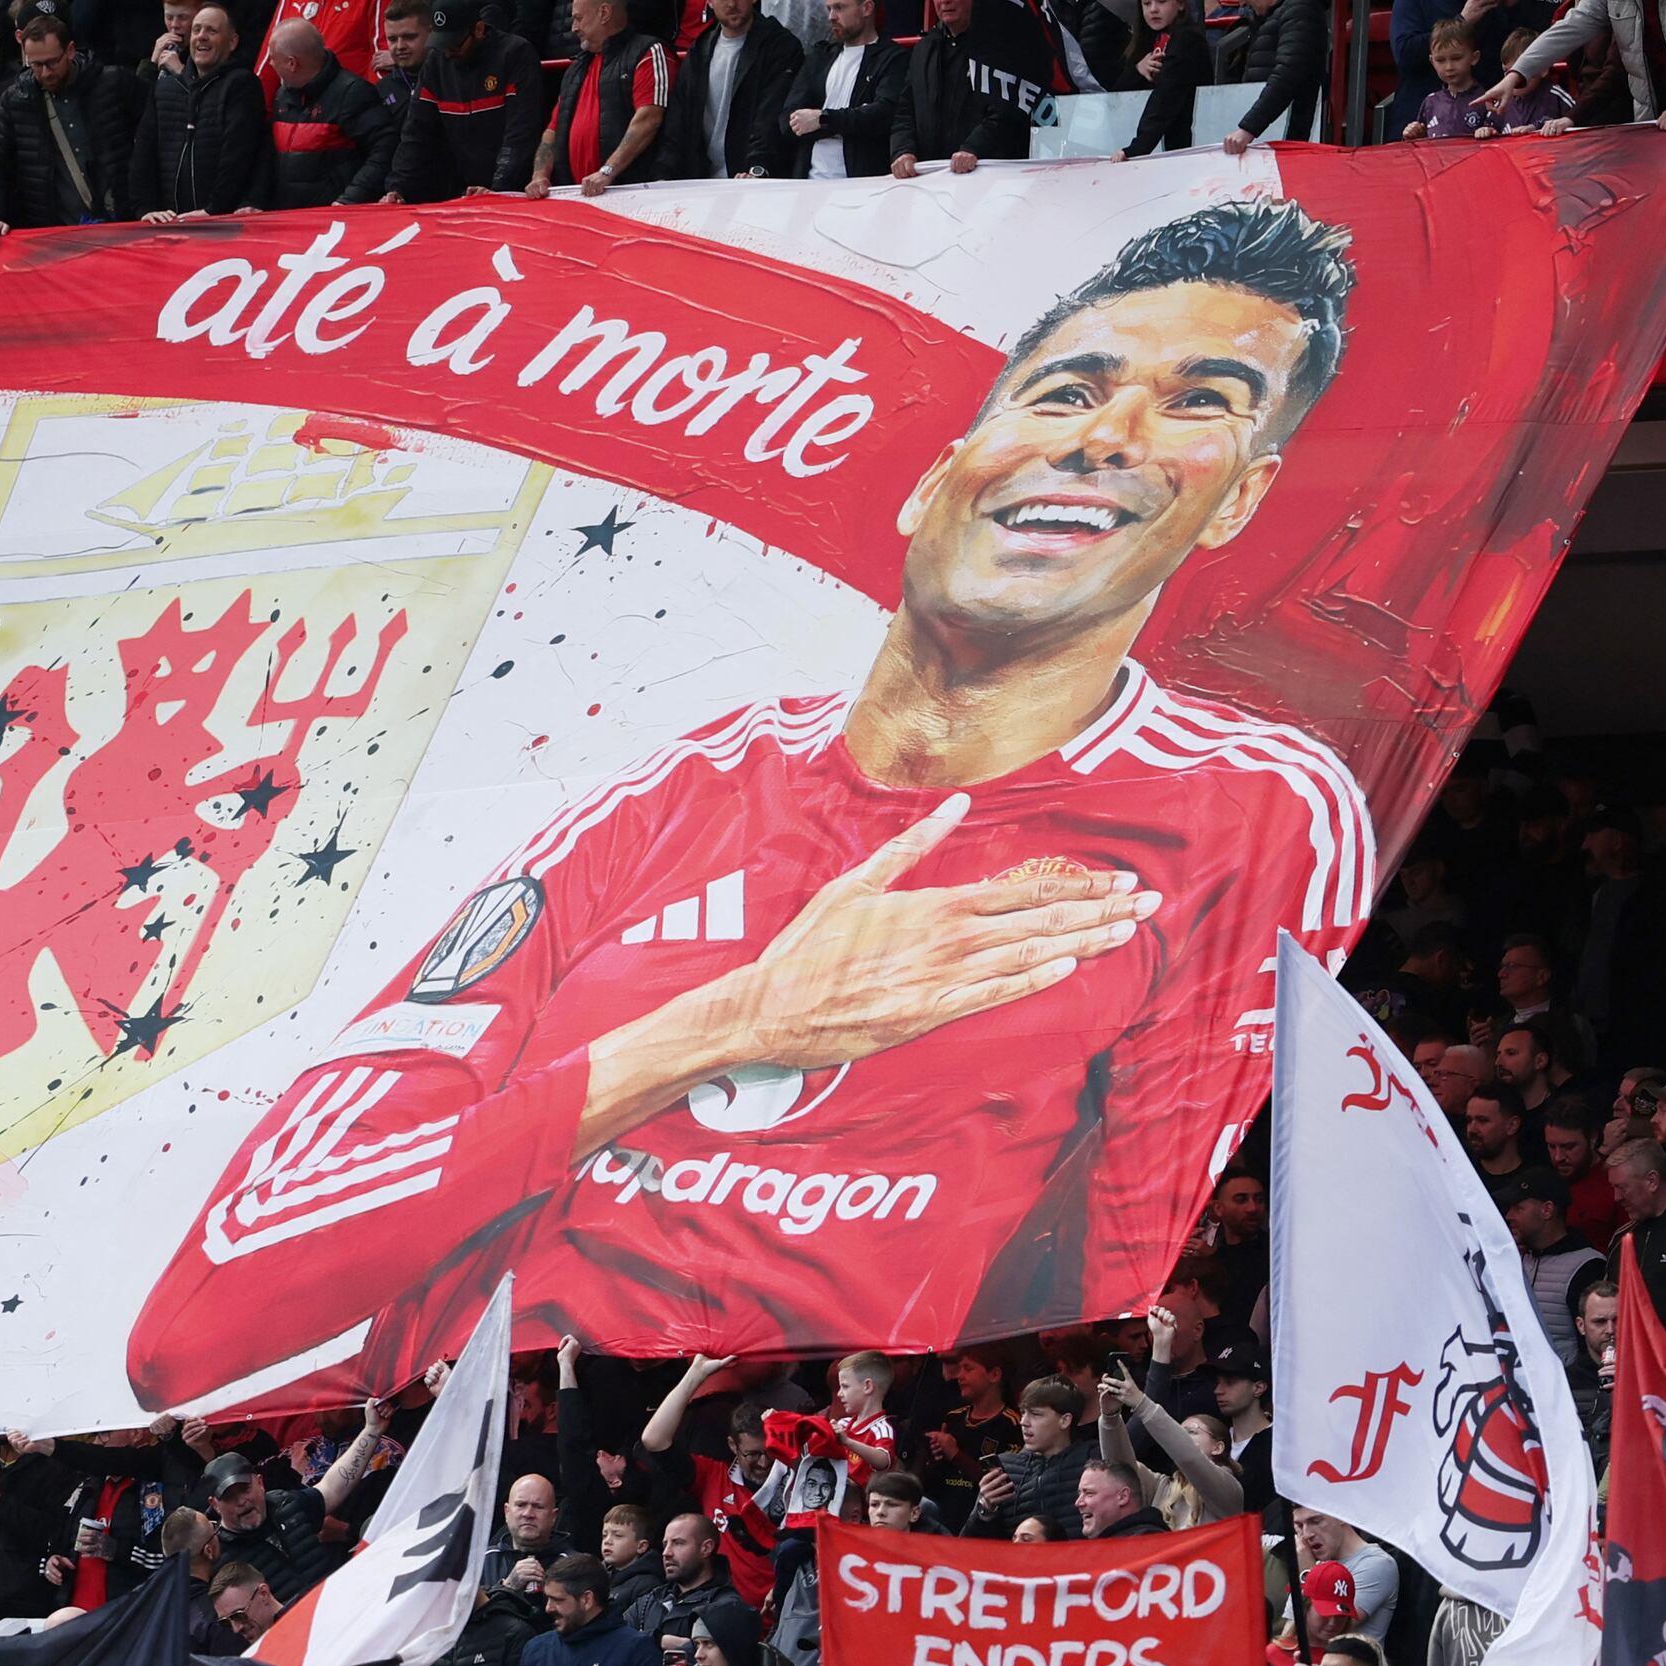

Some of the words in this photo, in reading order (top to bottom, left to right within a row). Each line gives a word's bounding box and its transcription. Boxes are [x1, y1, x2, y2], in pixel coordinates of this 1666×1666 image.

[156, 221, 422, 360] até
[405, 244, 524, 376] à
[519, 304, 875, 479] morte
[838, 1553, 1227, 1631] STRETFORD
